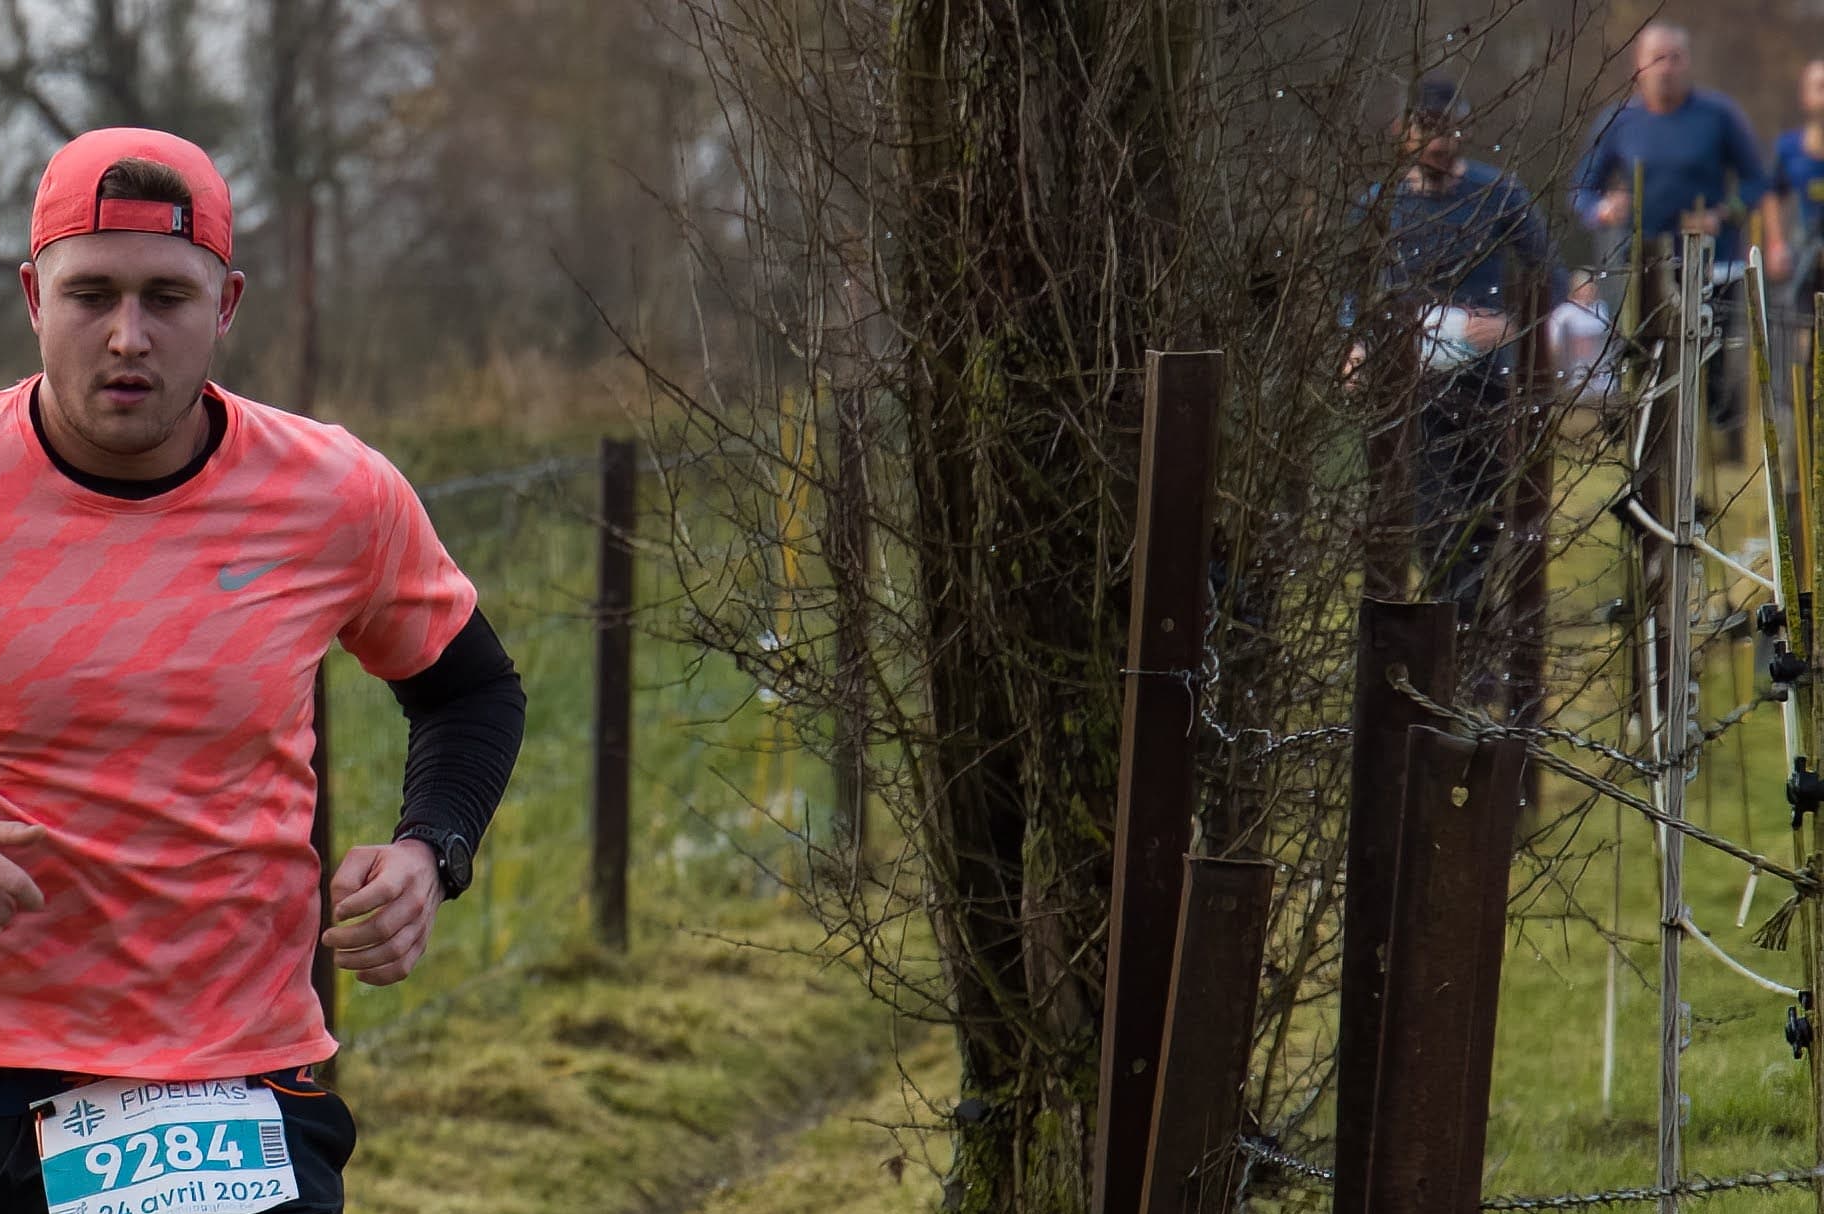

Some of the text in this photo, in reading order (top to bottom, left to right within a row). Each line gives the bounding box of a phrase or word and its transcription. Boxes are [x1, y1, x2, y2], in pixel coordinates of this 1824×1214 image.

[85, 1124, 244, 1190] 9284
[140, 1181, 205, 1214] avril
[214, 1178, 284, 1201] 2022
